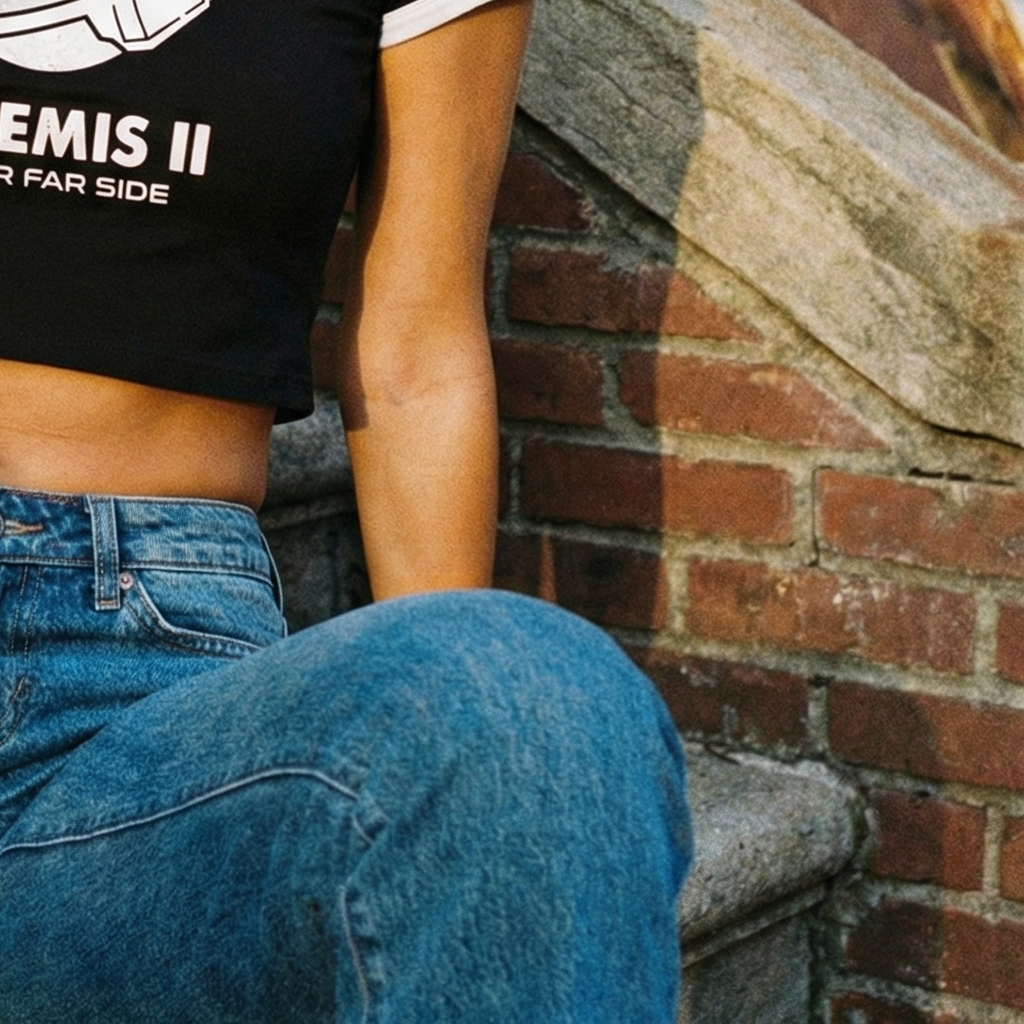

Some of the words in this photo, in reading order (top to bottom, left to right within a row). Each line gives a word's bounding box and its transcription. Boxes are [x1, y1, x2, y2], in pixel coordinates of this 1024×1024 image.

[168, 120, 211, 176] II
[23, 167, 87, 195] FAR
[95, 176, 170, 205] SIDE
